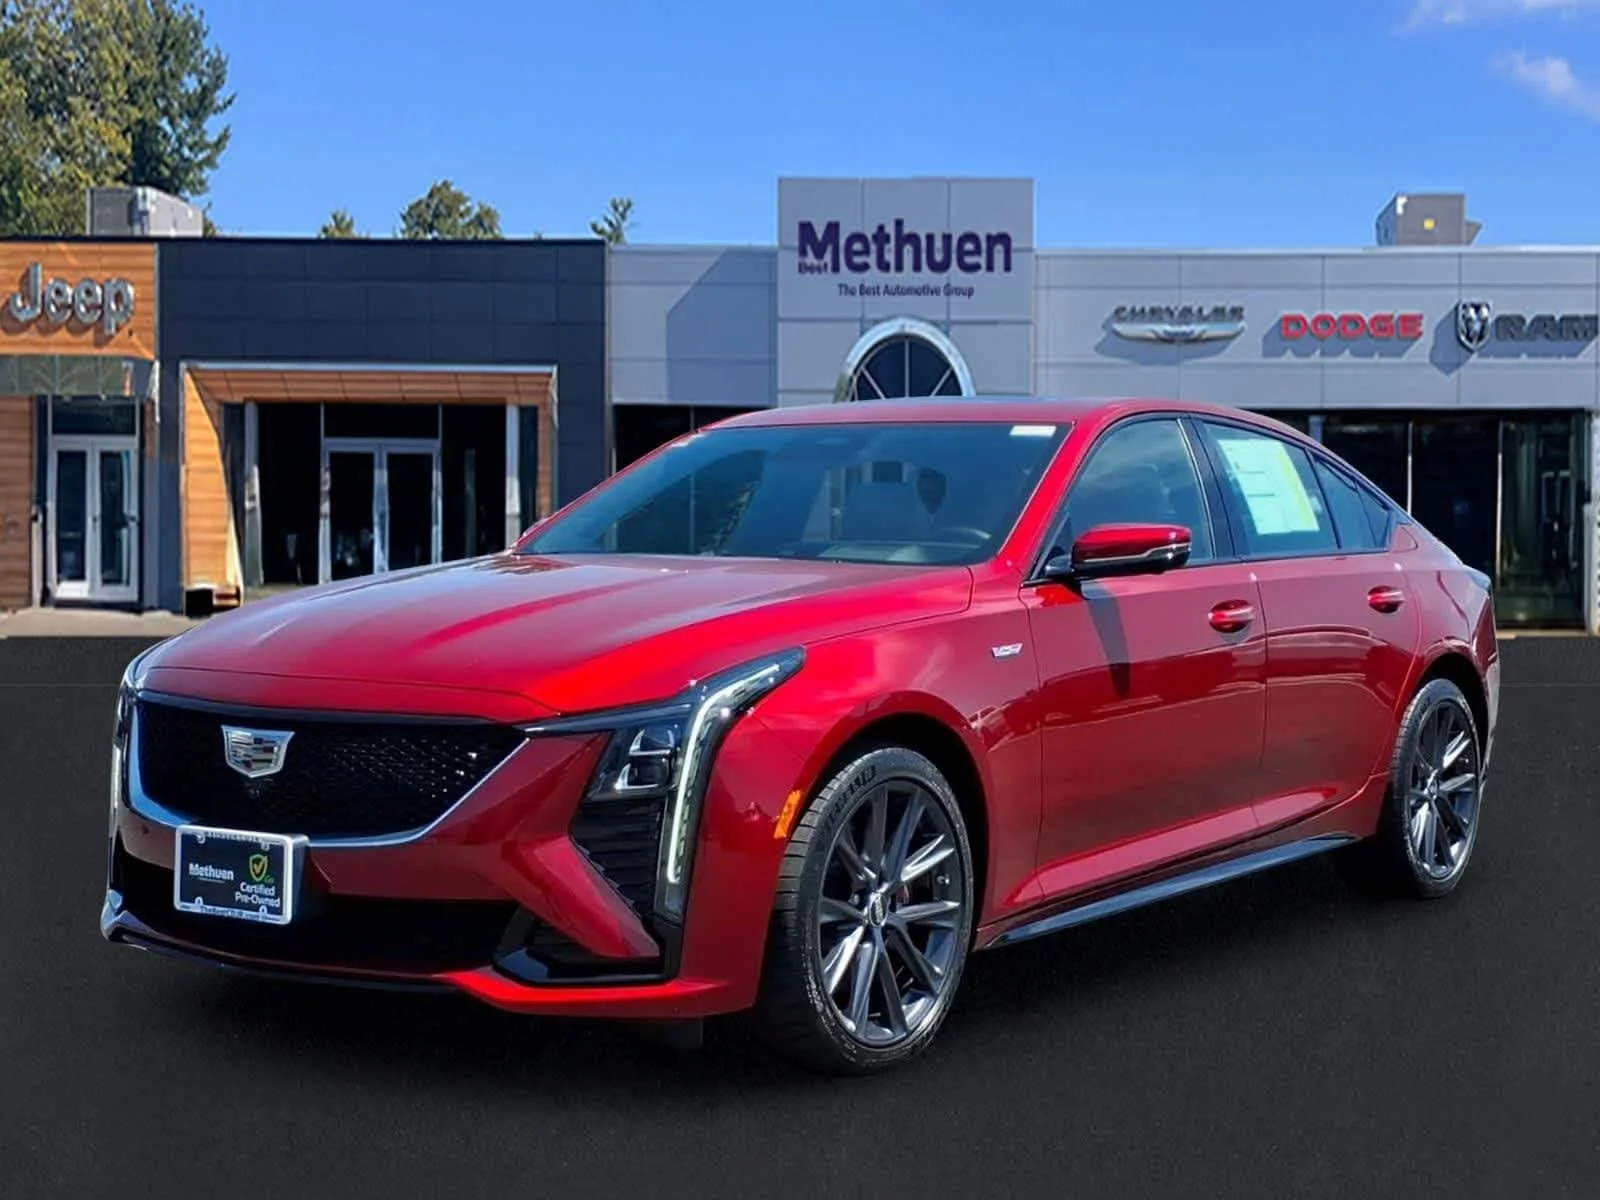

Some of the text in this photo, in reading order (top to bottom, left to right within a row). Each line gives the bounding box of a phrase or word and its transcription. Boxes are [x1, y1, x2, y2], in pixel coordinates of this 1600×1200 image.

[798, 218, 1012, 273] Methuen
[798, 262, 828, 274] Best
[9, 262, 135, 336] Jeep
[837, 282, 975, 299] The Best Automotive Group
[1113, 304, 1245, 322] CHRYSLER
[1280, 313, 1424, 340] DODGE
[1494, 313, 1599, 341] RAM
[189, 863, 234, 880] Methuen
[239, 882, 276, 897] Certified
[234, 892, 281, 908] Pre-Owned
